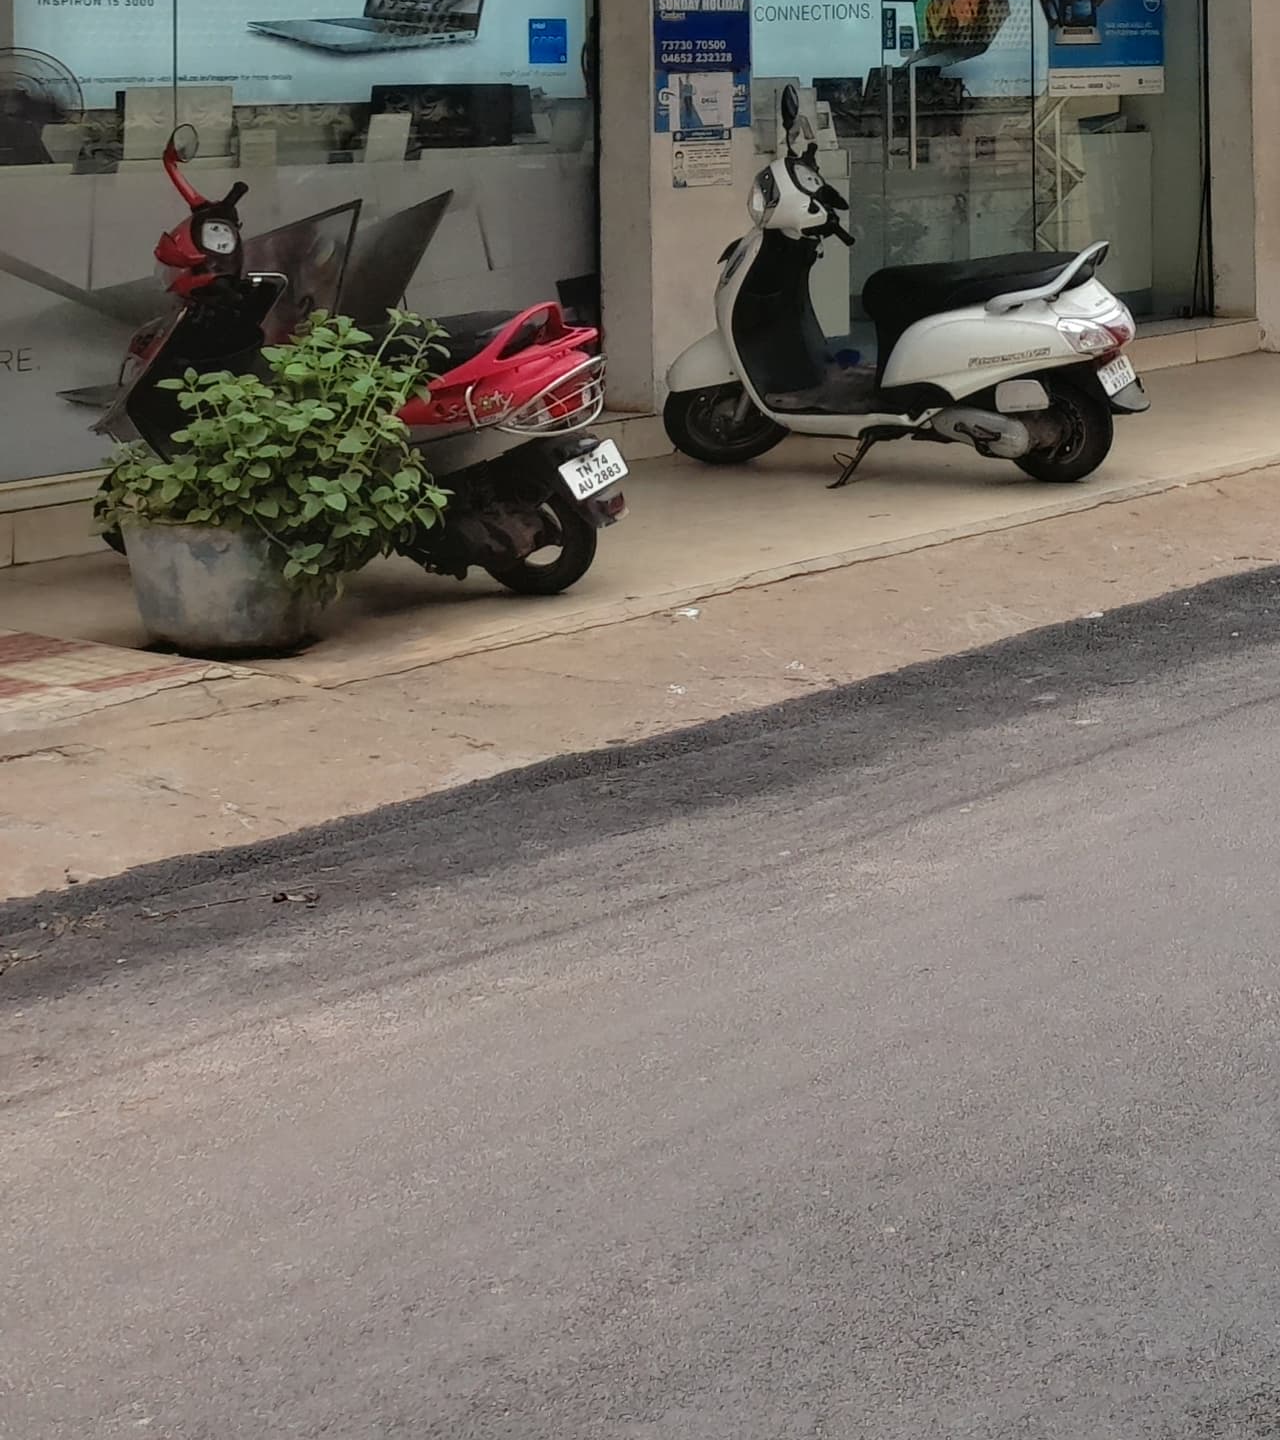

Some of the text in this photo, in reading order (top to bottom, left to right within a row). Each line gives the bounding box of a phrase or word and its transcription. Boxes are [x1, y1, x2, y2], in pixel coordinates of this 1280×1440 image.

[576, 453, 609, 479] TN 74
[578, 462, 622, 495] AU 2883
